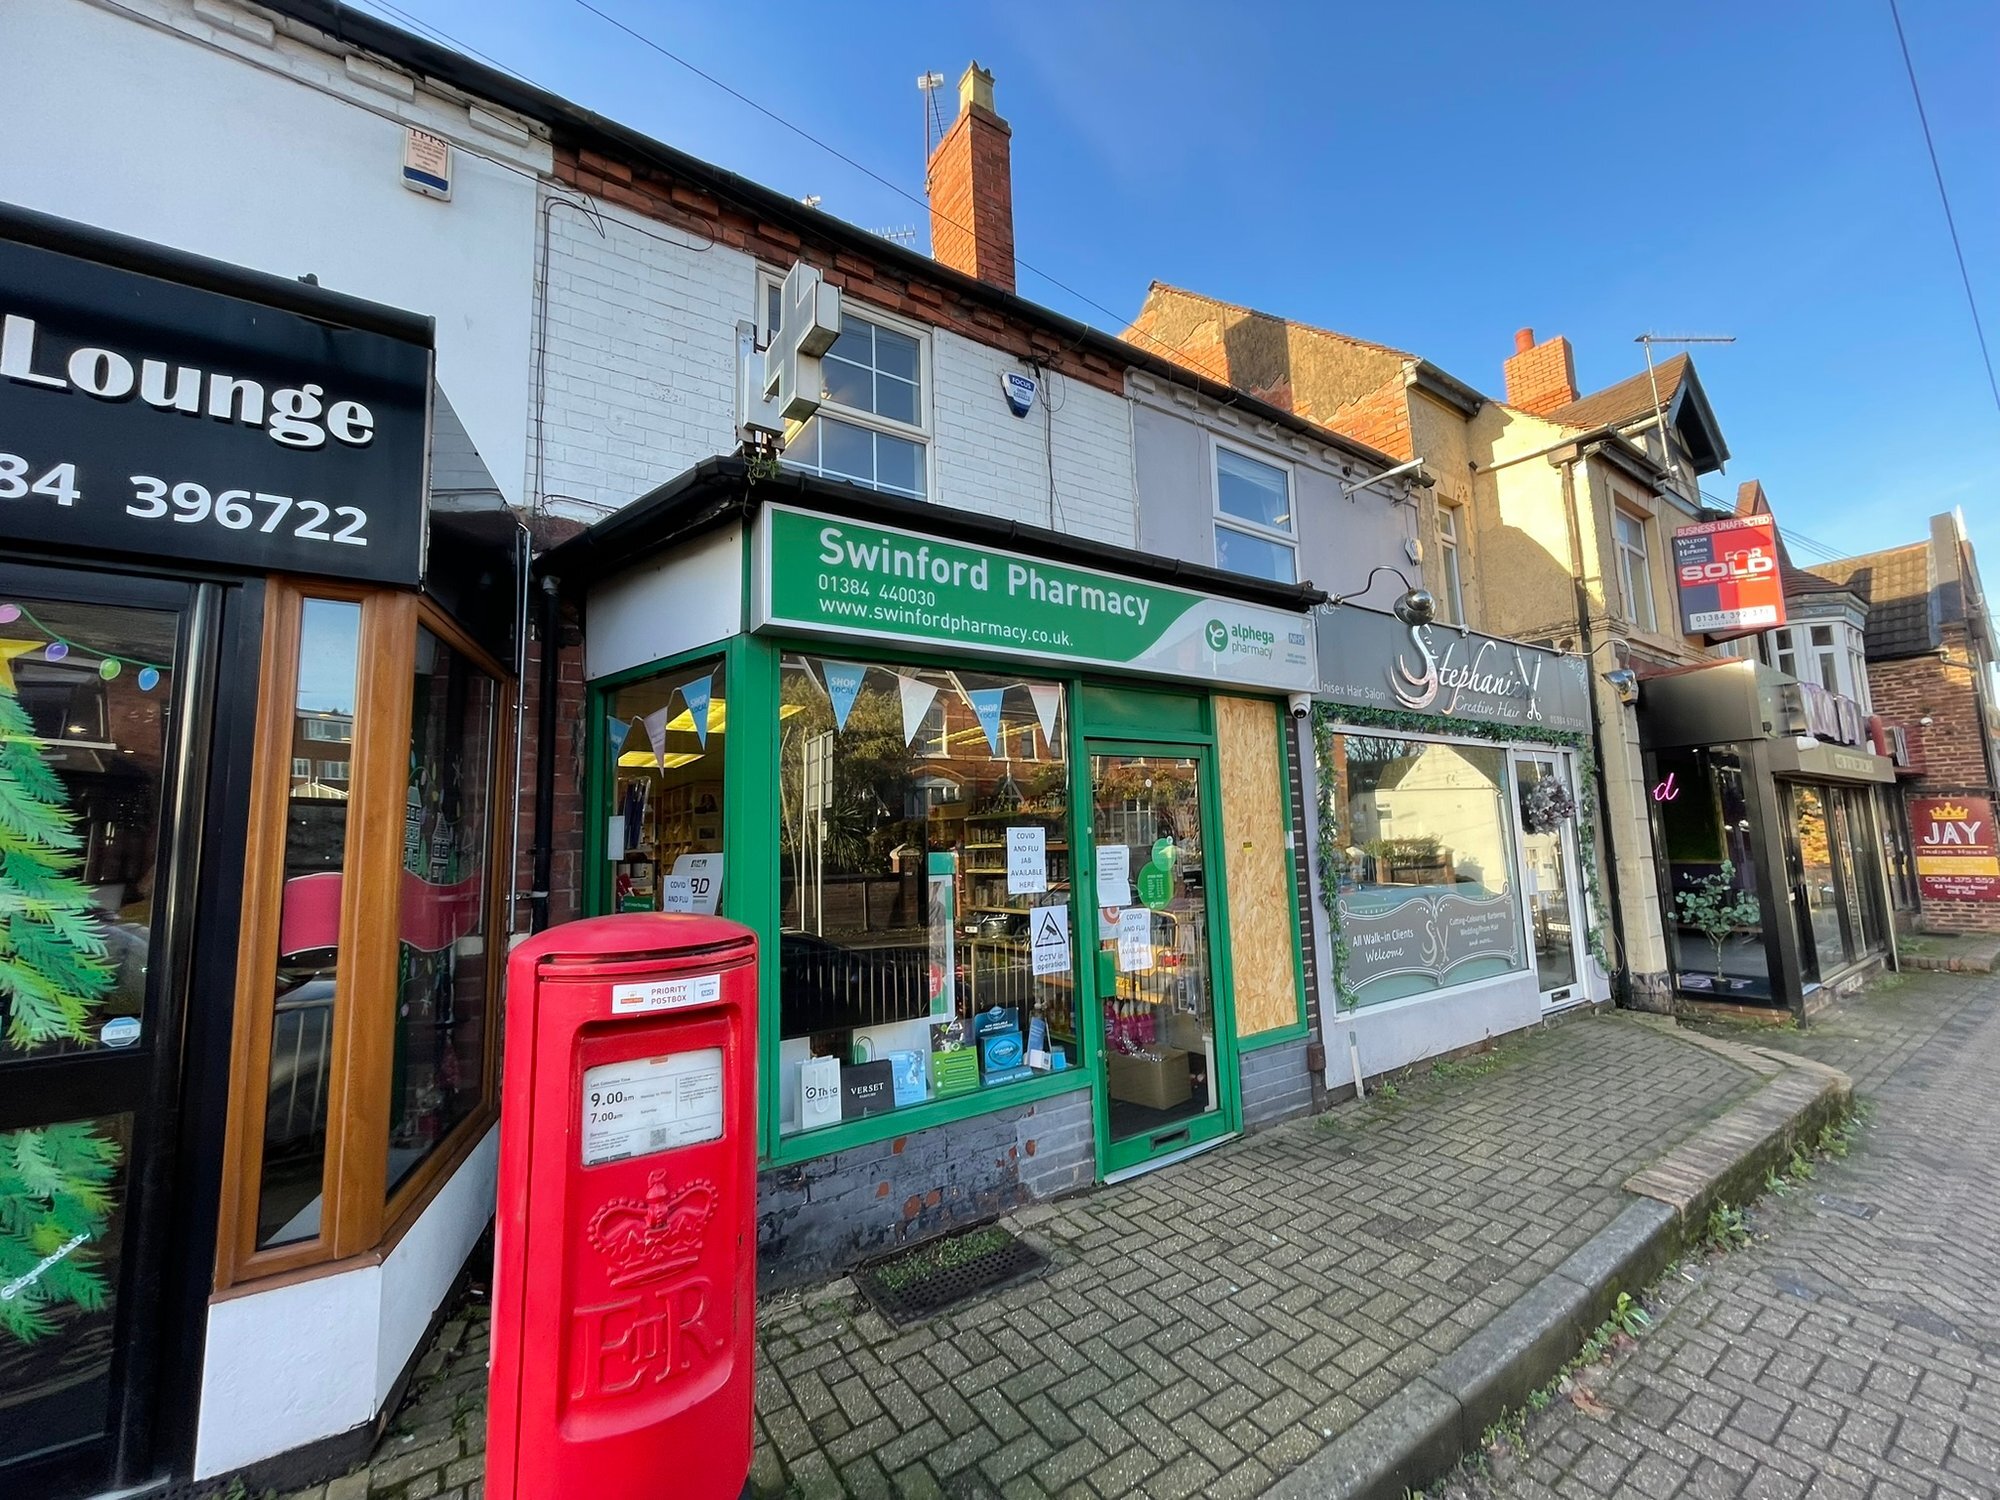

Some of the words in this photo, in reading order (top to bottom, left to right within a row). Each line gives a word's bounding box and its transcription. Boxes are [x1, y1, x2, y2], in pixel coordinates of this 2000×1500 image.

[1, 314, 374, 448] Lounge
[126, 475, 368, 546] 396722
[1677, 523, 1715, 537] BUSINESS
[1681, 557, 1773, 581] SOLD
[818, 527, 989, 591] Swinford
[1008, 563, 1150, 626] Pharmacy
[818, 574, 870, 597] 01384
[878, 583, 936, 607] 440030
[1696, 613, 1725, 622] 01384
[1231, 623, 1275, 645] alphega
[1288, 633, 1306, 646] NHS
[1231, 641, 1273, 660] pharmacy
[831, 677, 855, 687] SHOP
[831, 686, 854, 695] LOCAL
[1319, 680, 1345, 695] Unisex
[1347, 684, 1362, 697] Hair
[1365, 687, 1386, 700] Salon
[978, 704, 998, 713] SHOP
[1455, 695, 1495, 715] Creative
[1498, 702, 1520, 718] Hair
[1016, 832, 1036, 840] COVID
[1923, 821, 1982, 845] JAY
[1010, 868, 1042, 876] AVAILABLE
[1126, 912, 1142, 920] COVID
[1124, 924, 1136, 932] AND
[1352, 934, 1362, 947] All
[1363, 932, 1391, 945] Walk-in
[1392, 929, 1414, 940] Clients
[1039, 953, 1057, 962] CCTV
[1058, 952, 1064, 960] in
[1365, 947, 1405, 963] Welcome
[1037, 960, 1066, 971] operation
[651, 985, 688, 996] PRIORITY
[651, 994, 687, 1005] POSTBOX
[850, 1082, 884, 1095] VERSET
[590, 1092, 634, 1108] 9.00am
